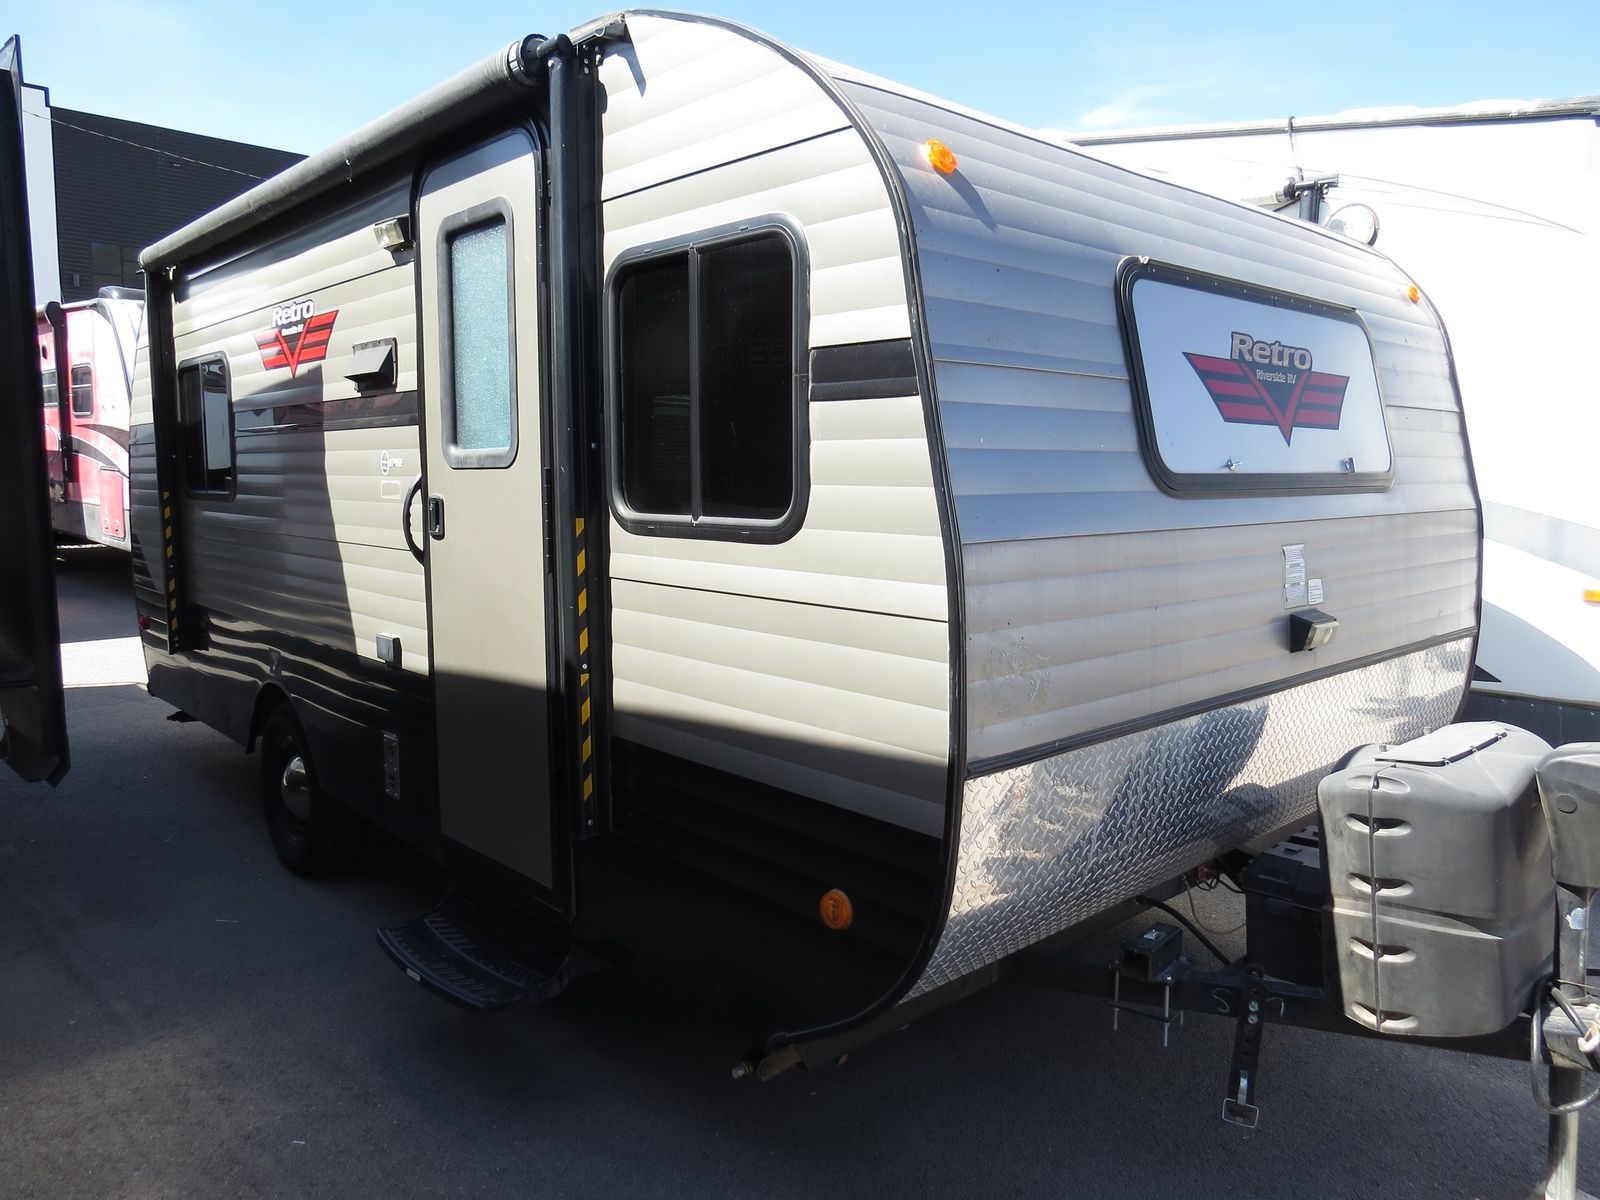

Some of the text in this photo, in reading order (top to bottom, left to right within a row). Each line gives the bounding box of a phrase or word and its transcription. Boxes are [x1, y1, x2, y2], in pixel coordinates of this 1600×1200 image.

[271, 299, 314, 328] Retro
[1231, 332, 1312, 370] Retro
[1256, 369, 1297, 384] Riverside RV
